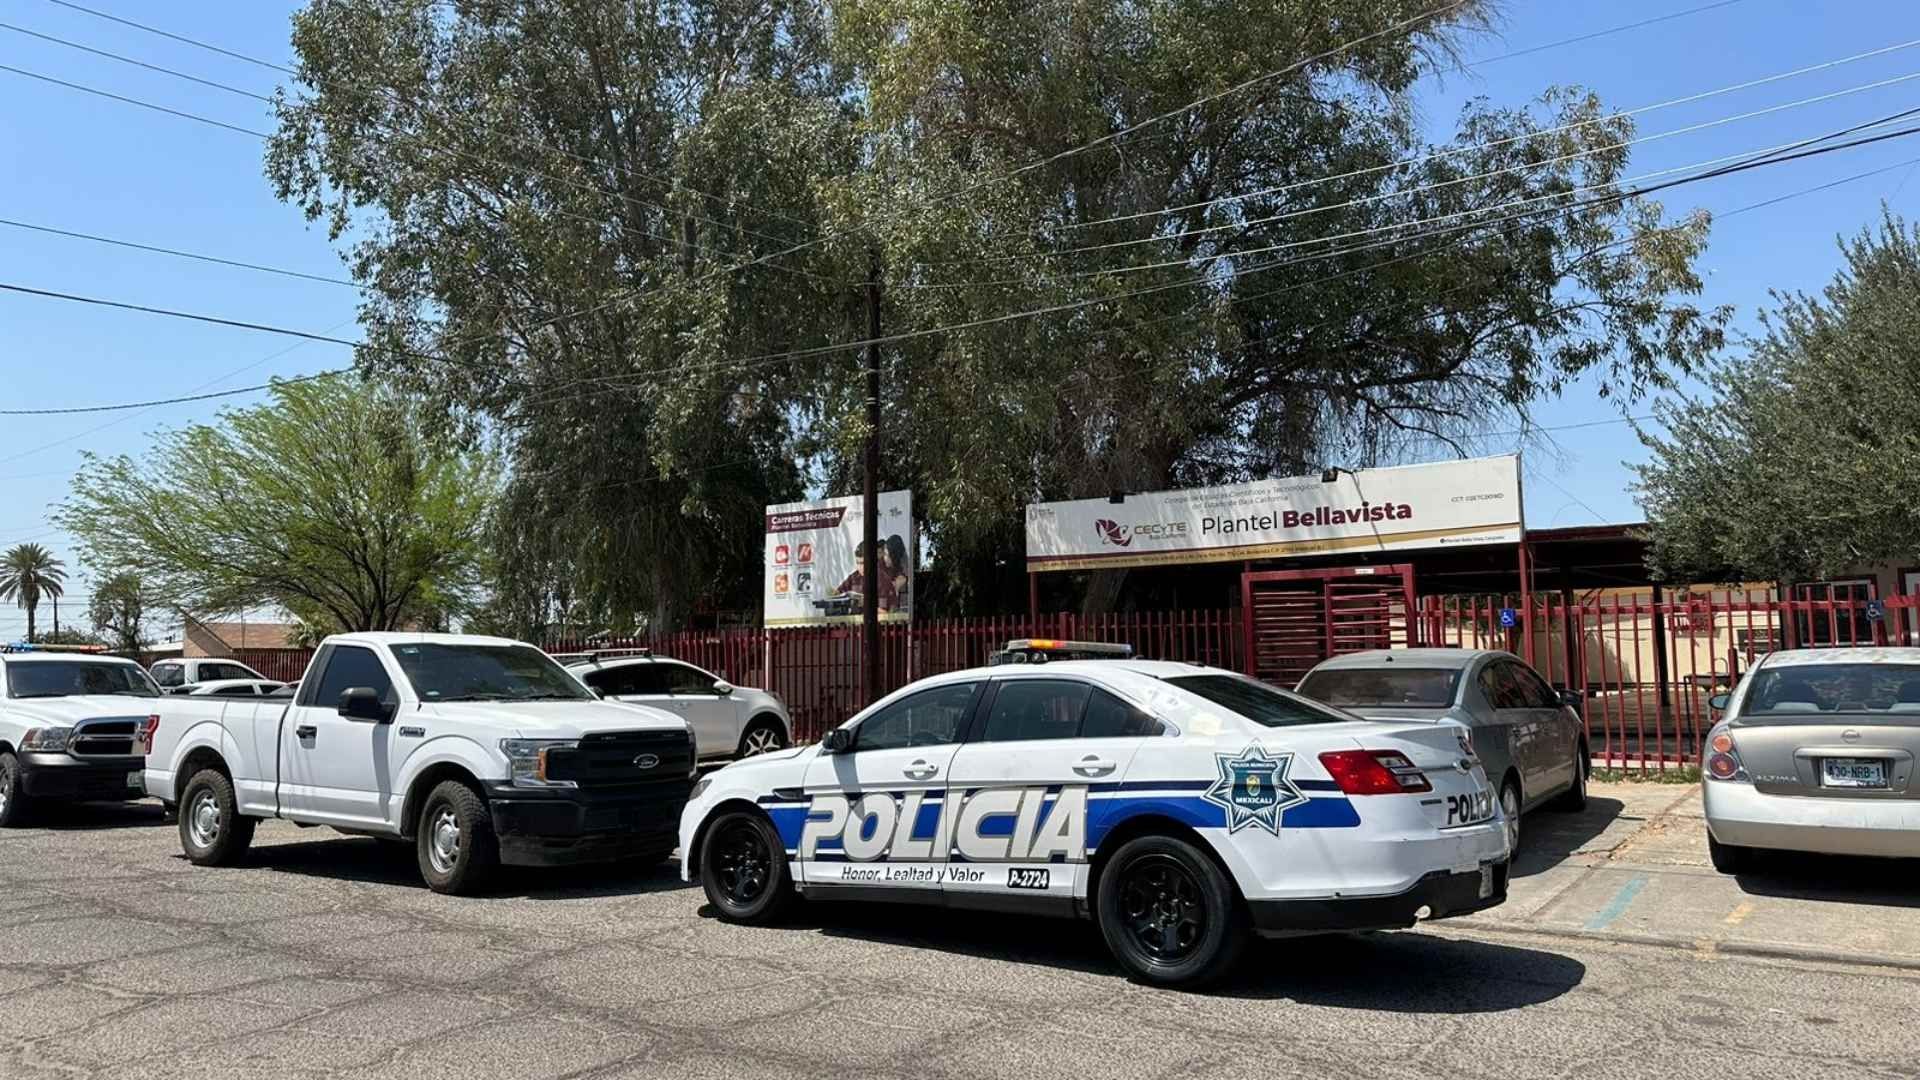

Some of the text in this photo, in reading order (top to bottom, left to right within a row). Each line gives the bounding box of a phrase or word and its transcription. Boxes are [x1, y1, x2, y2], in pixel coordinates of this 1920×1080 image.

[1202, 502, 1412, 535] Plantel Bellavista
[795, 784, 1089, 862] POLICIA
[841, 866, 985, 884] Honor, Lealtad y Valor
[1008, 869, 1049, 888] P-2724
